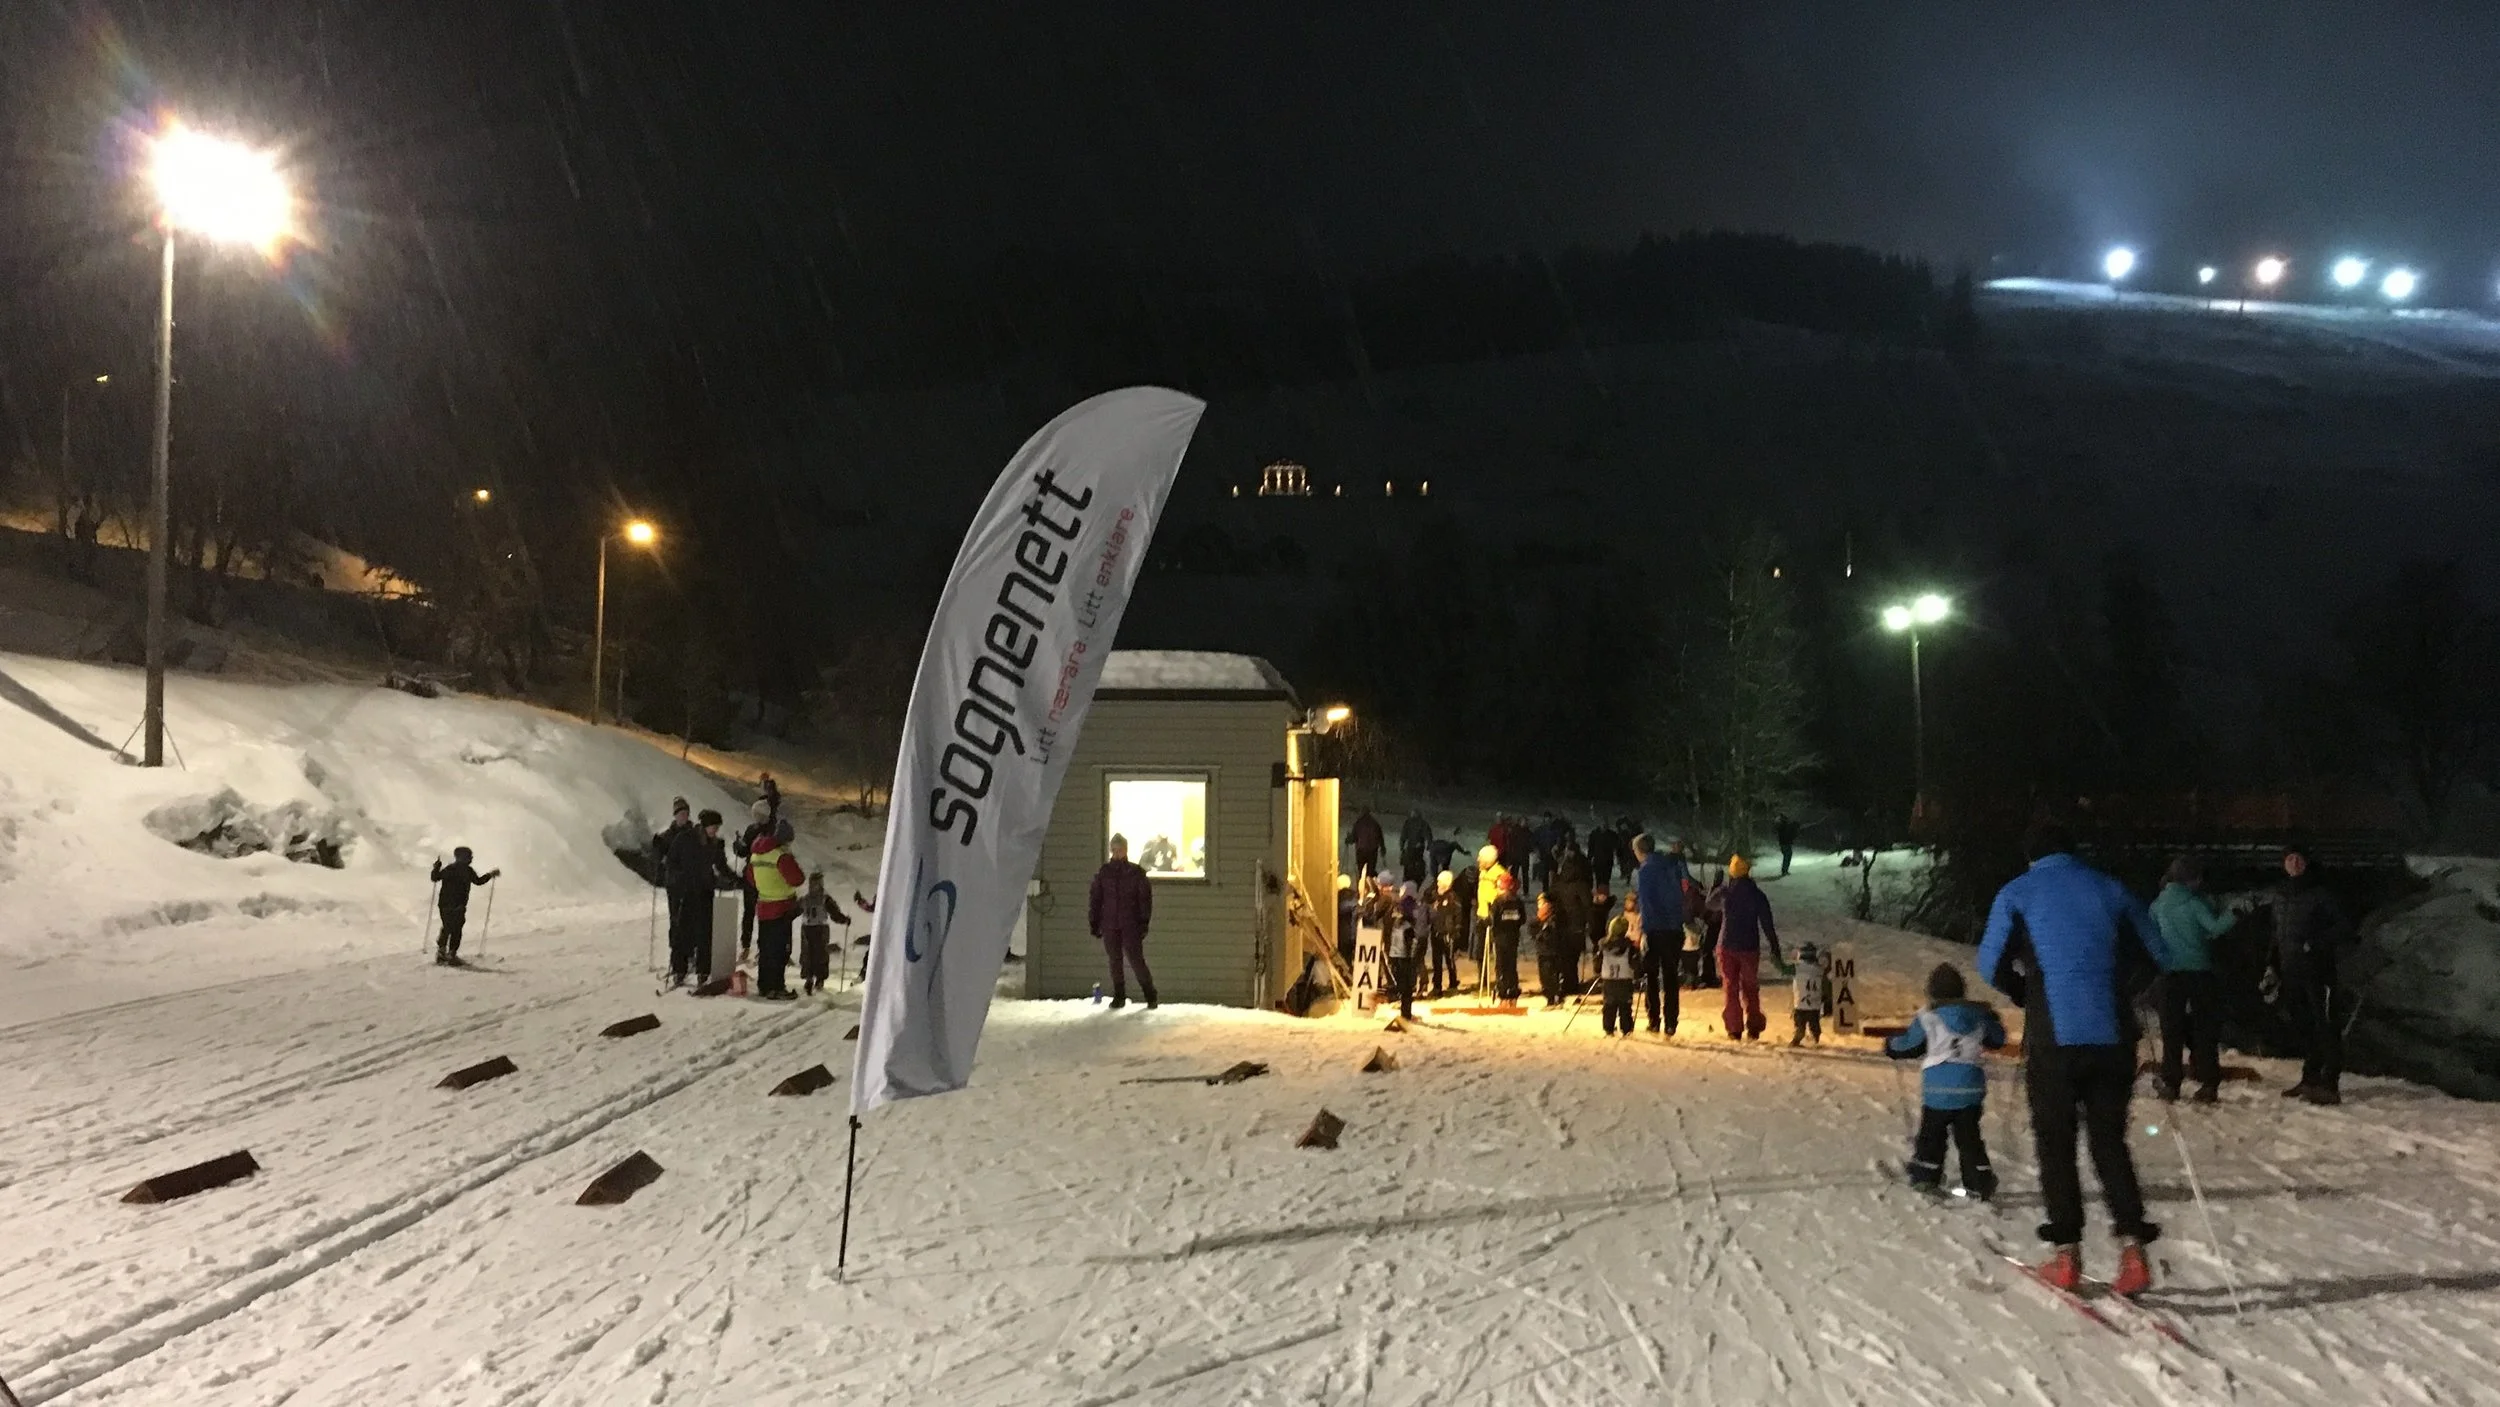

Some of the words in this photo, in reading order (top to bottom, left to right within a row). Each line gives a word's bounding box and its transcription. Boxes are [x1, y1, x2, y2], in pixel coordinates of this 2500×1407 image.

[930, 469, 1092, 846] sognenett
[1030, 727, 1057, 765] Litt
[1078, 588, 1103, 630] Litt
[1357, 944, 1377, 1011] MÅL
[1835, 959, 1855, 1028] MÅL
